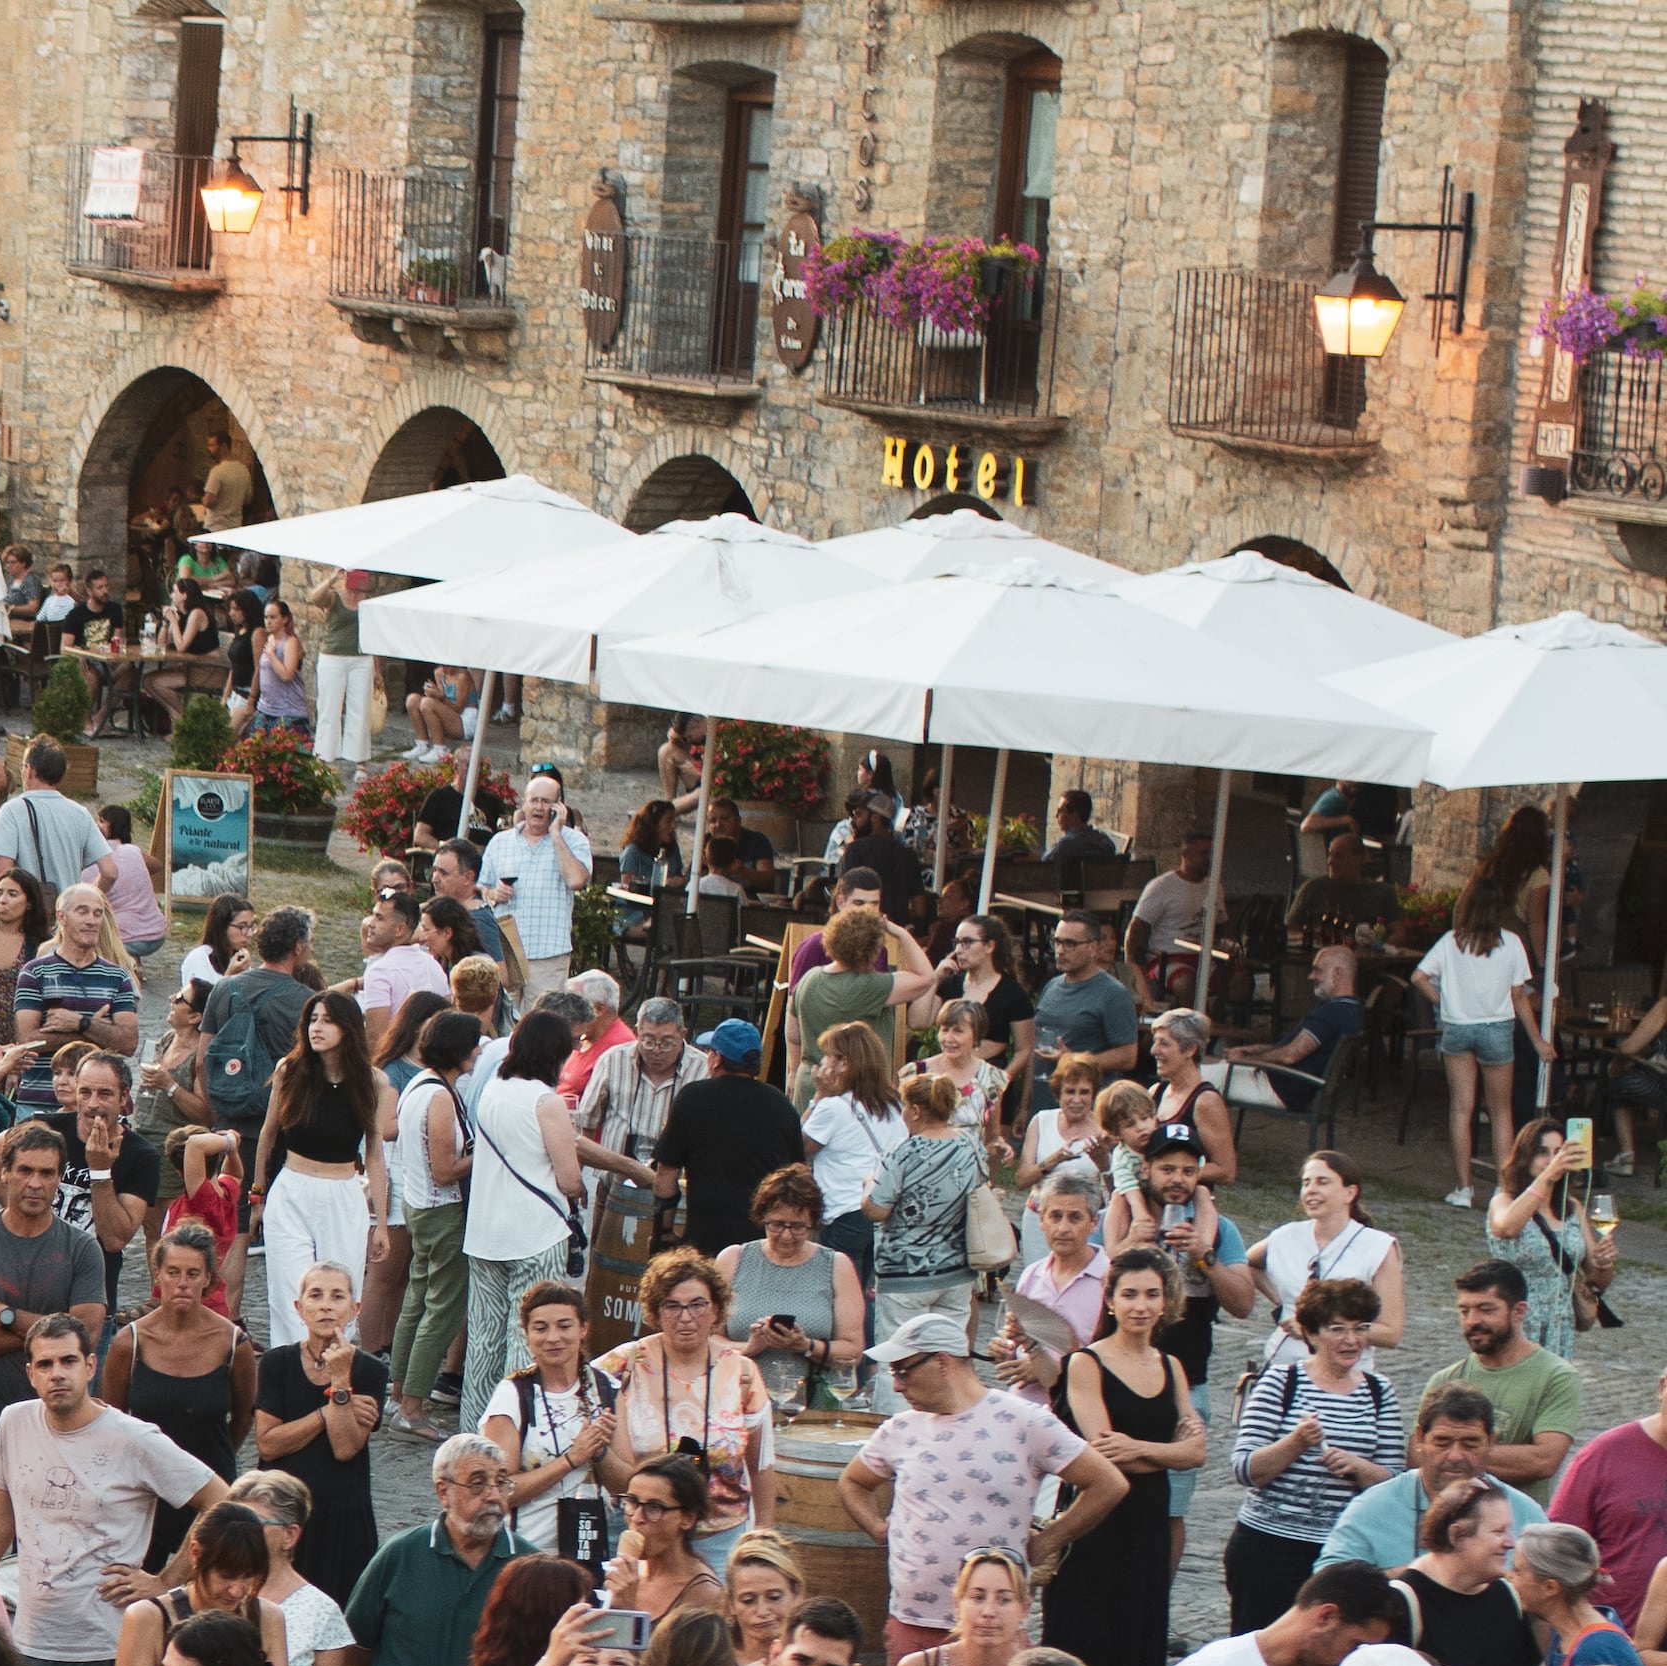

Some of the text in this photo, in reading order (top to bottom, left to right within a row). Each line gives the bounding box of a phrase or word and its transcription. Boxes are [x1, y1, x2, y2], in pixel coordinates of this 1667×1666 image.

[203, 839, 240, 851] natural
[578, 1520, 591, 1530] SO
[578, 1530, 598, 1540] MON
[578, 1540, 589, 1550] TA
[577, 1550, 590, 1560] NO
